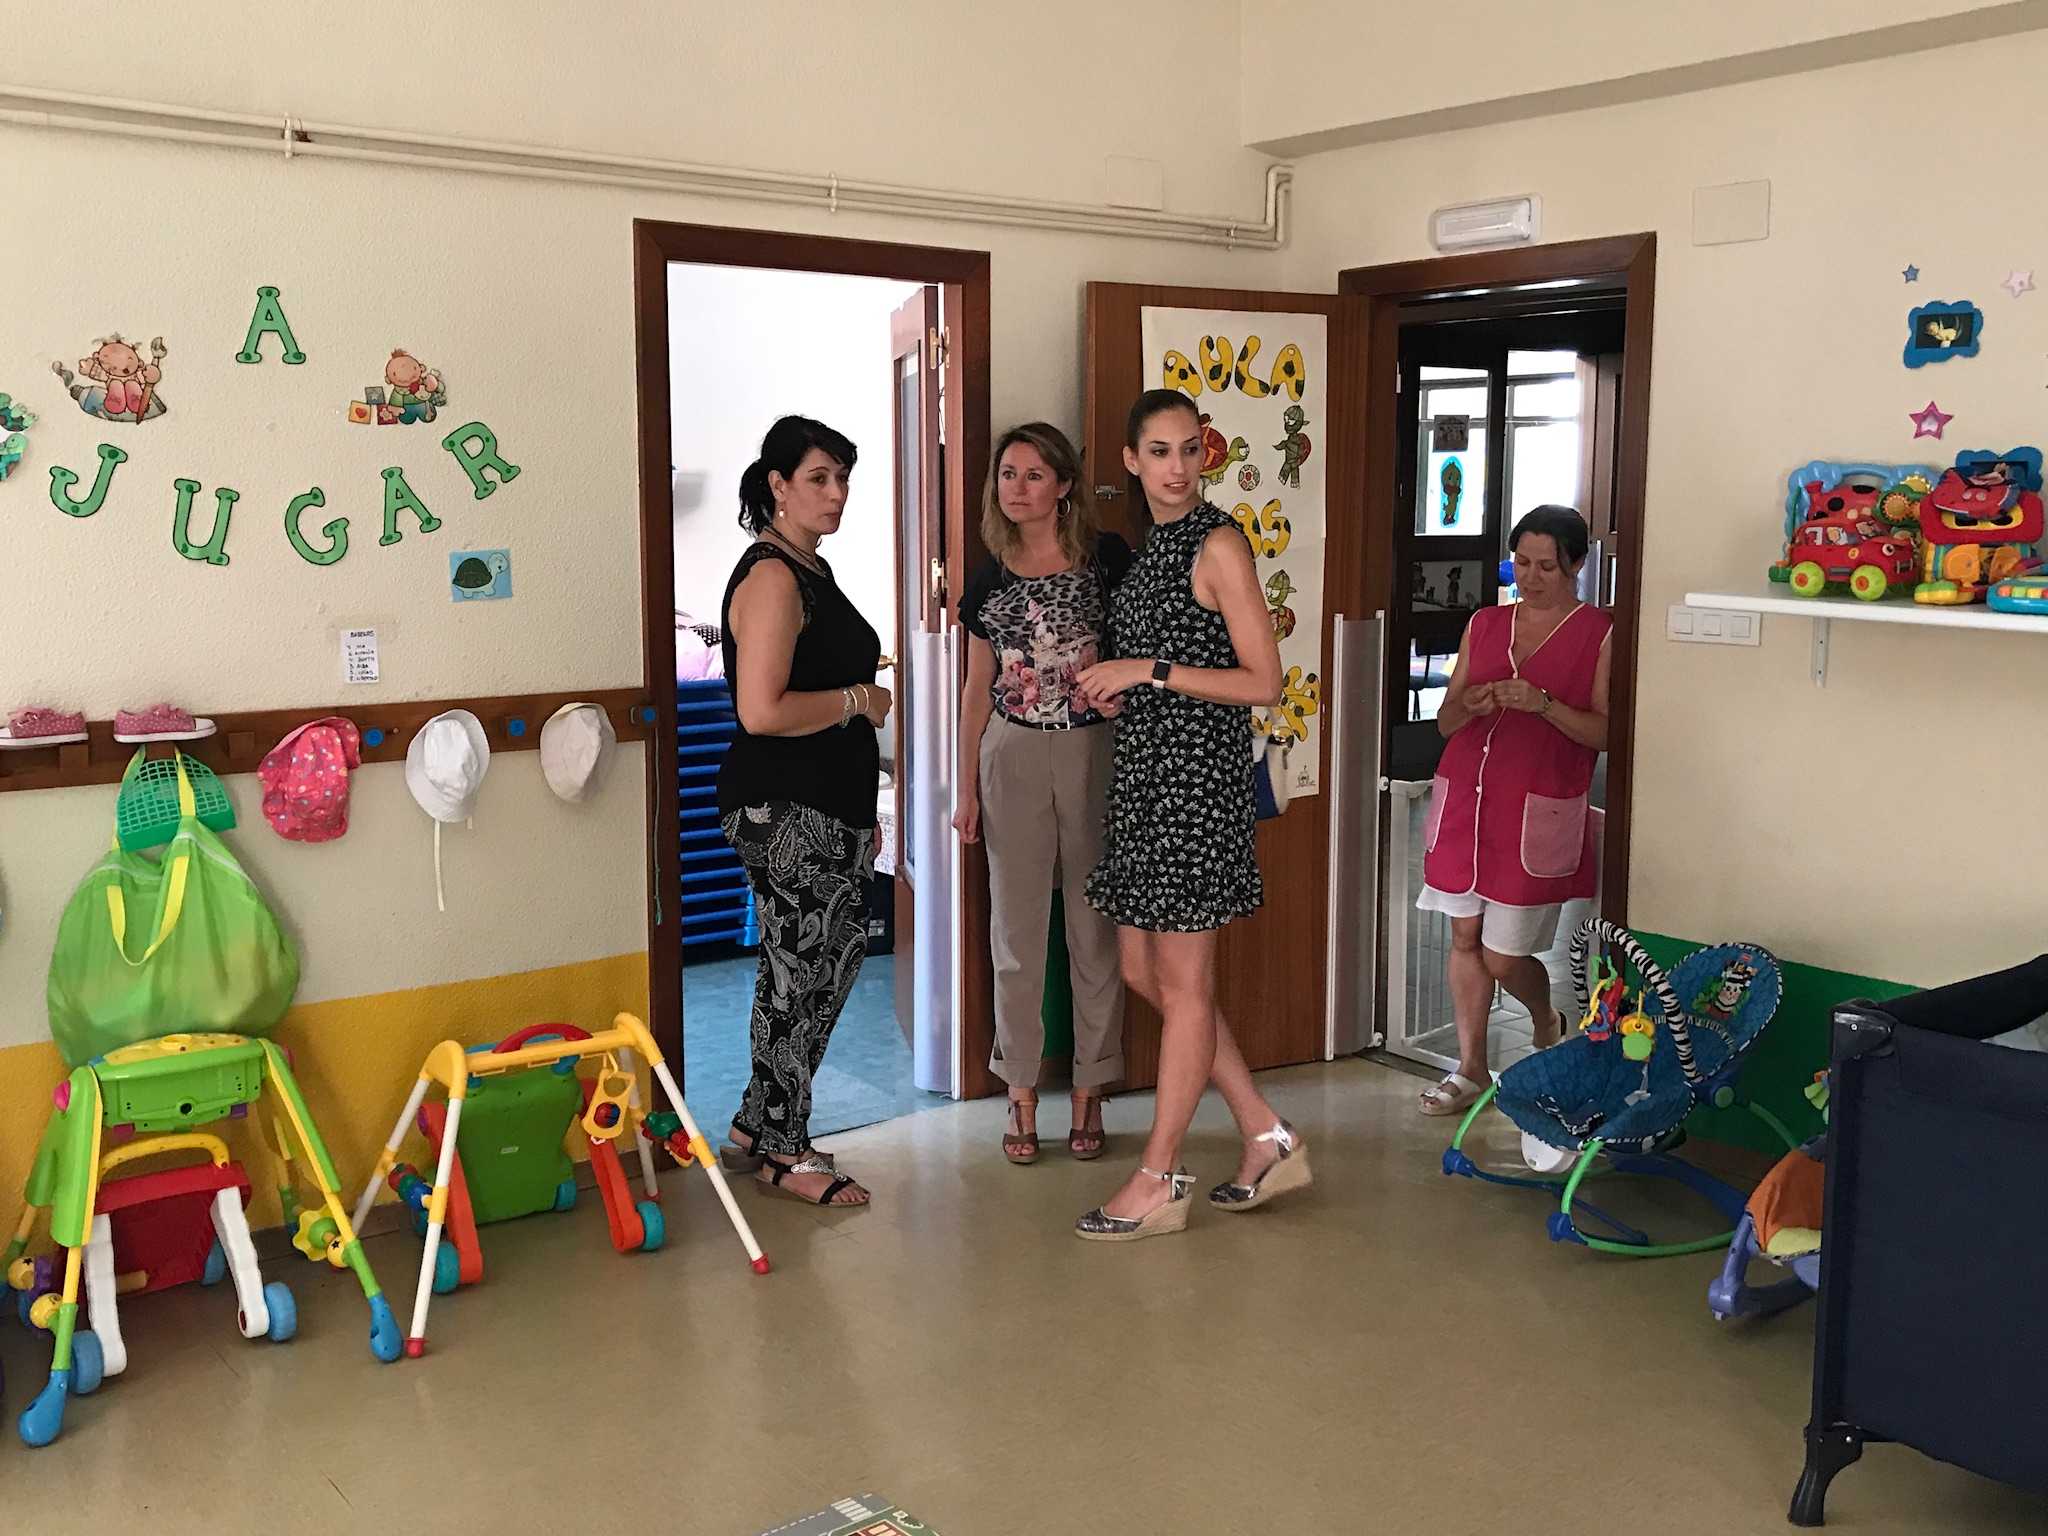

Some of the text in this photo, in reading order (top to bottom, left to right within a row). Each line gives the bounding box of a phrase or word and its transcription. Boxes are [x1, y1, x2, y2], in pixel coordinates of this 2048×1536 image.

[235, 286, 306, 364] A
[1163, 335, 1306, 402] AULA
[50, 422, 520, 566] JUGAR
[1231, 498, 1291, 559] AS
